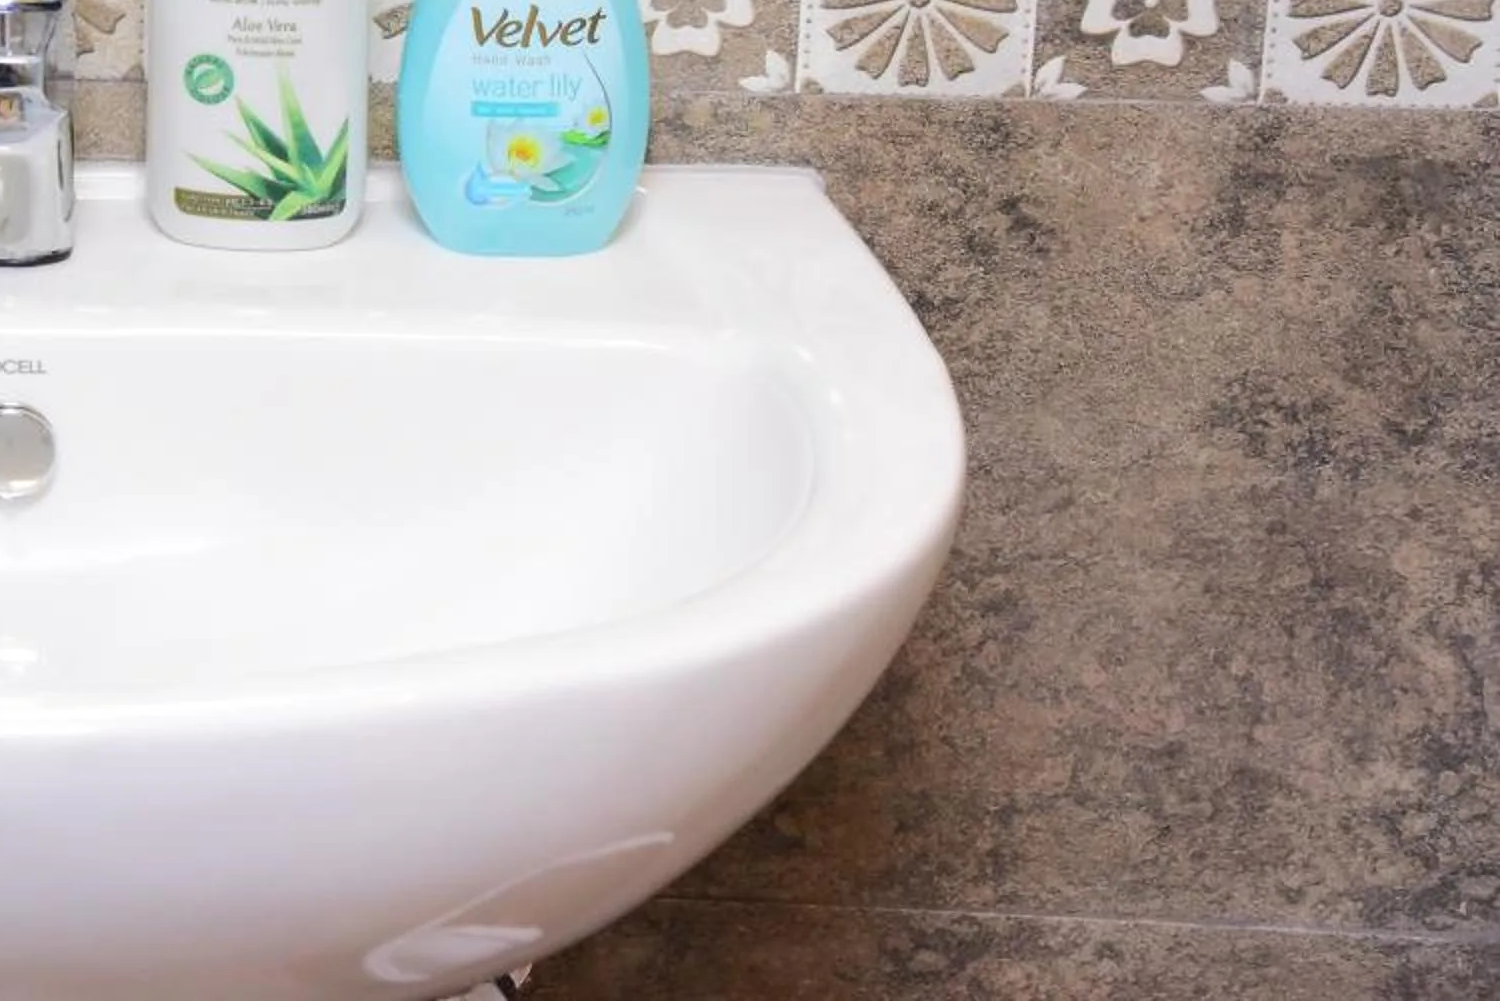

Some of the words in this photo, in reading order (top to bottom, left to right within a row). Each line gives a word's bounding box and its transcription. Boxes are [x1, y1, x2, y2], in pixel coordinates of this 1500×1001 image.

[232, 16, 263, 31] Aloe
[266, 16, 298, 31] Vera
[470, 3, 607, 49] Velvet
[471, 78, 544, 98] water
[550, 72, 583, 103] lily
